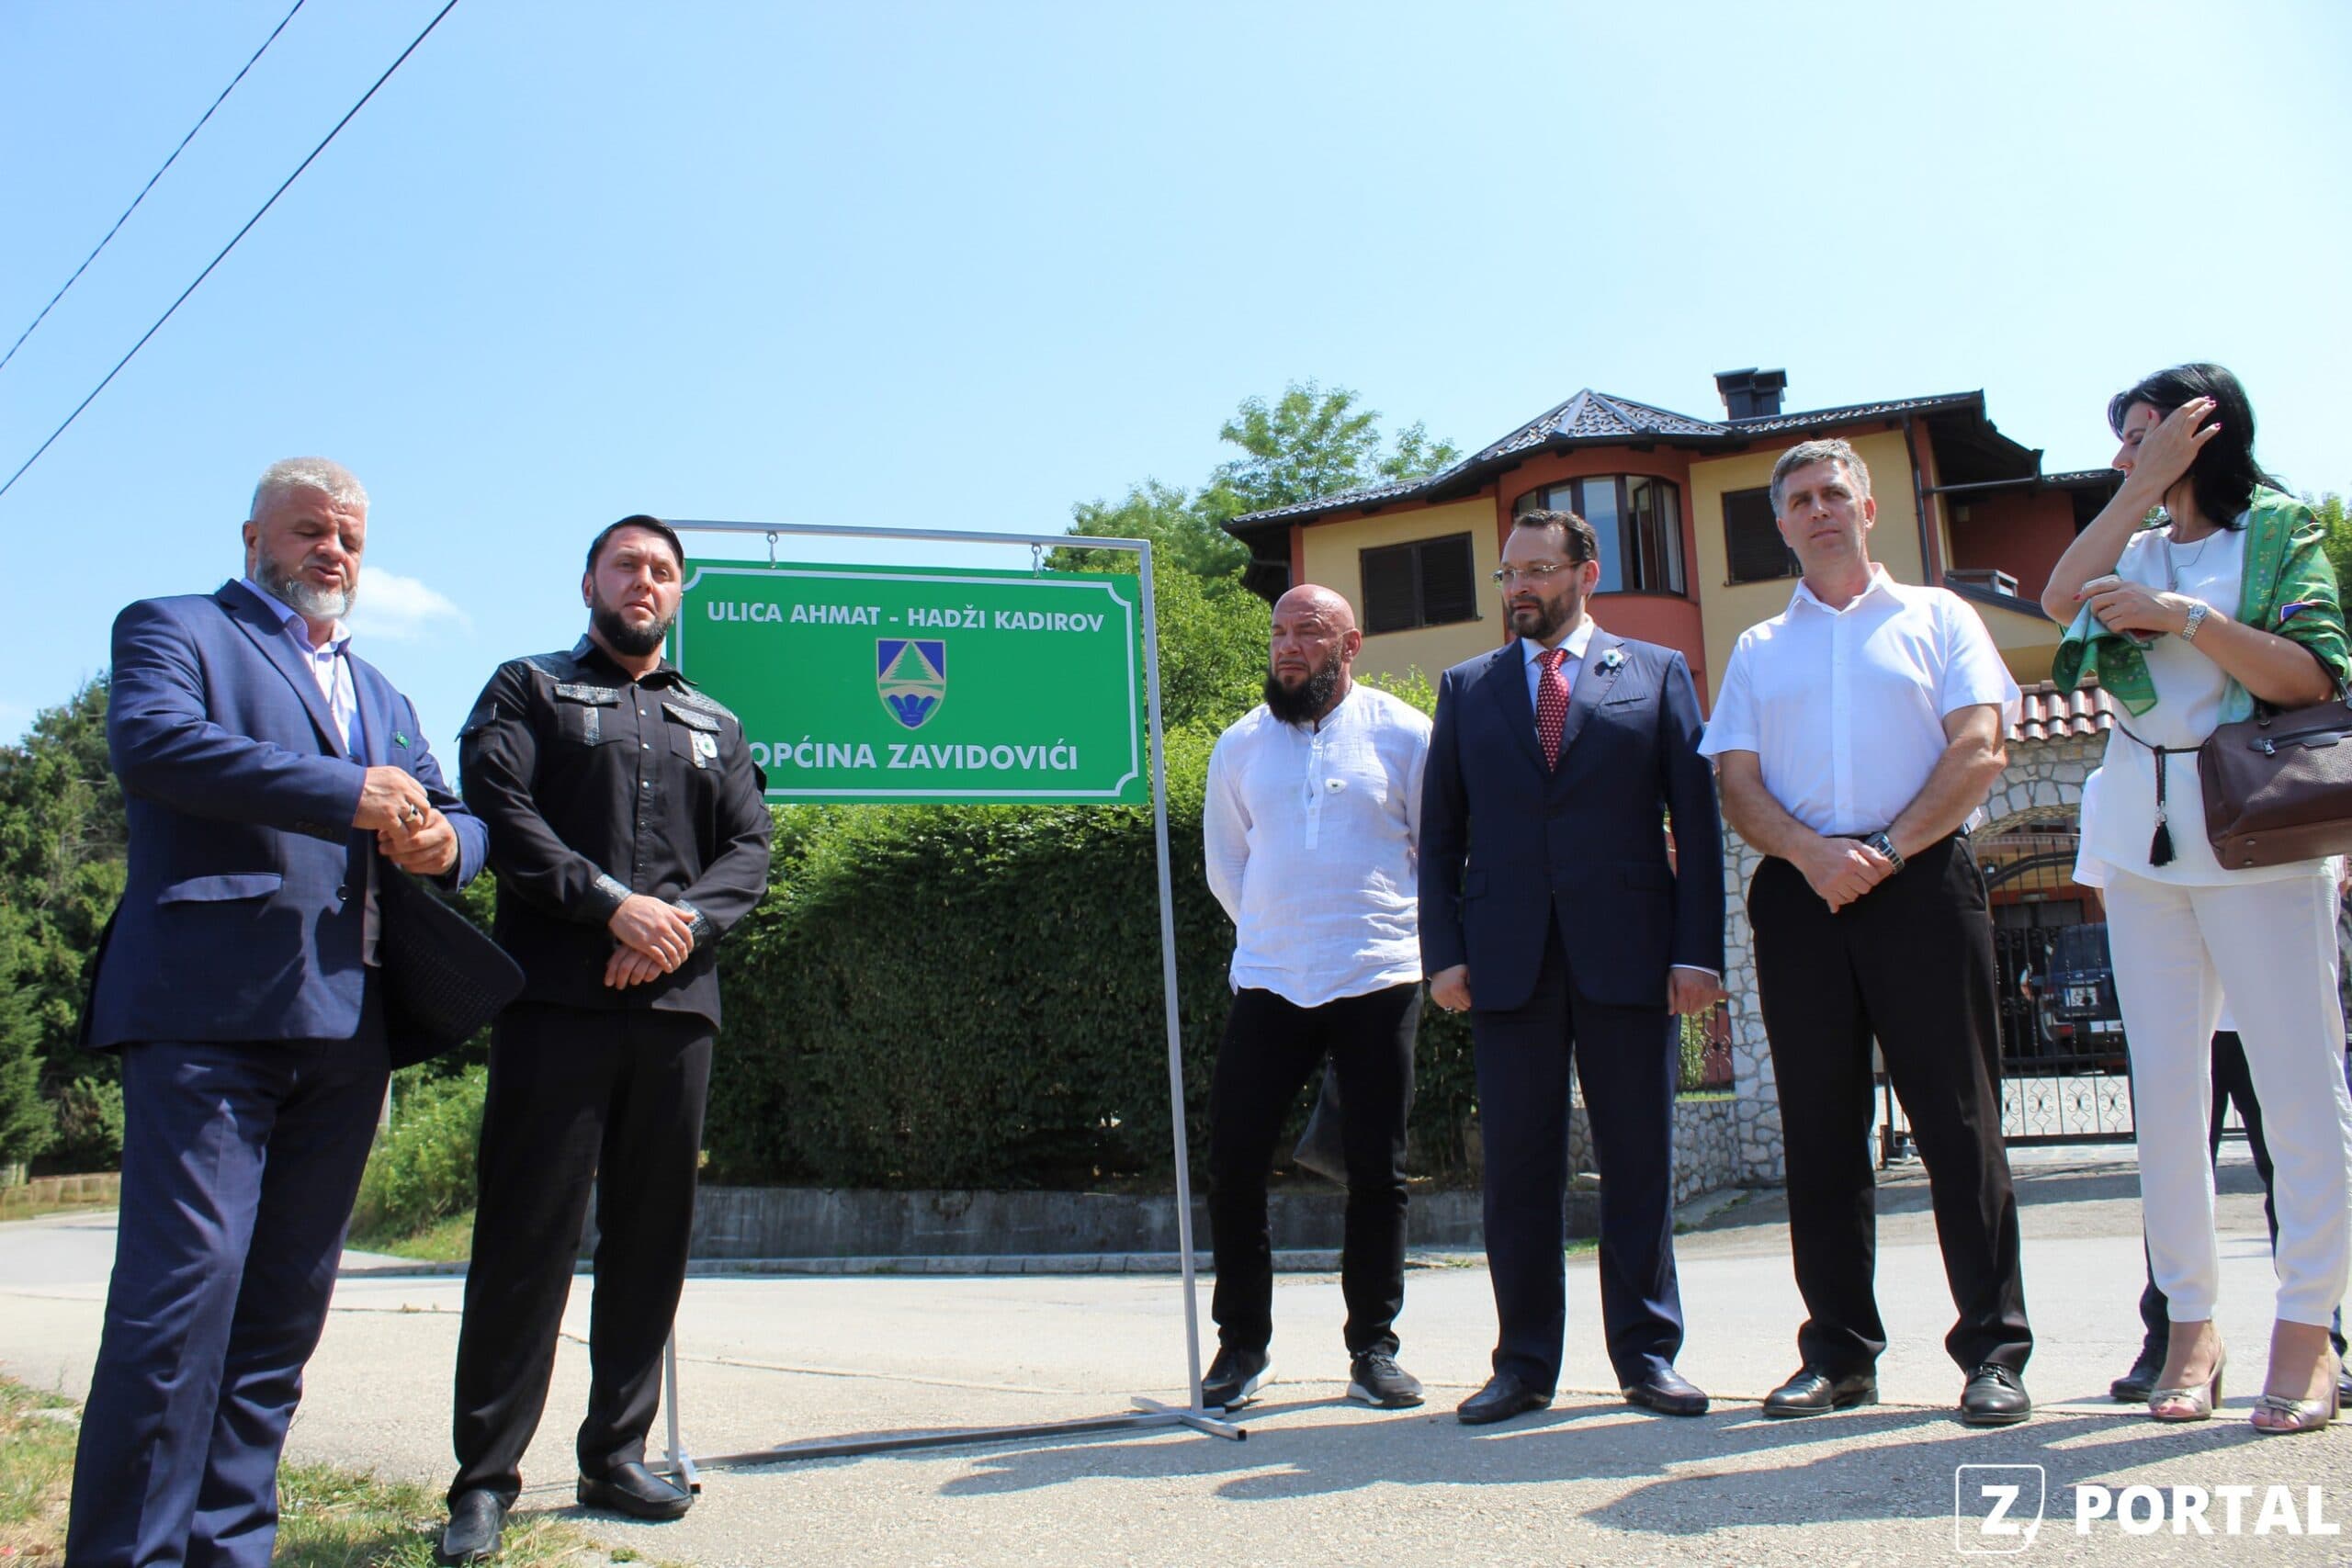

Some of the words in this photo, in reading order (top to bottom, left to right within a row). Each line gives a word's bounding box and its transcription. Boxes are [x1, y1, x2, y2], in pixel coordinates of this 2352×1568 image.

[707, 601, 784, 623] ULICA
[789, 604, 881, 626] AHMAT
[908, 604, 986, 629] HADŽI
[995, 611, 1104, 633] KADIROV
[749, 735, 877, 769] OPĆINA
[887, 738, 1078, 771] ZAVIDOVIĆI
